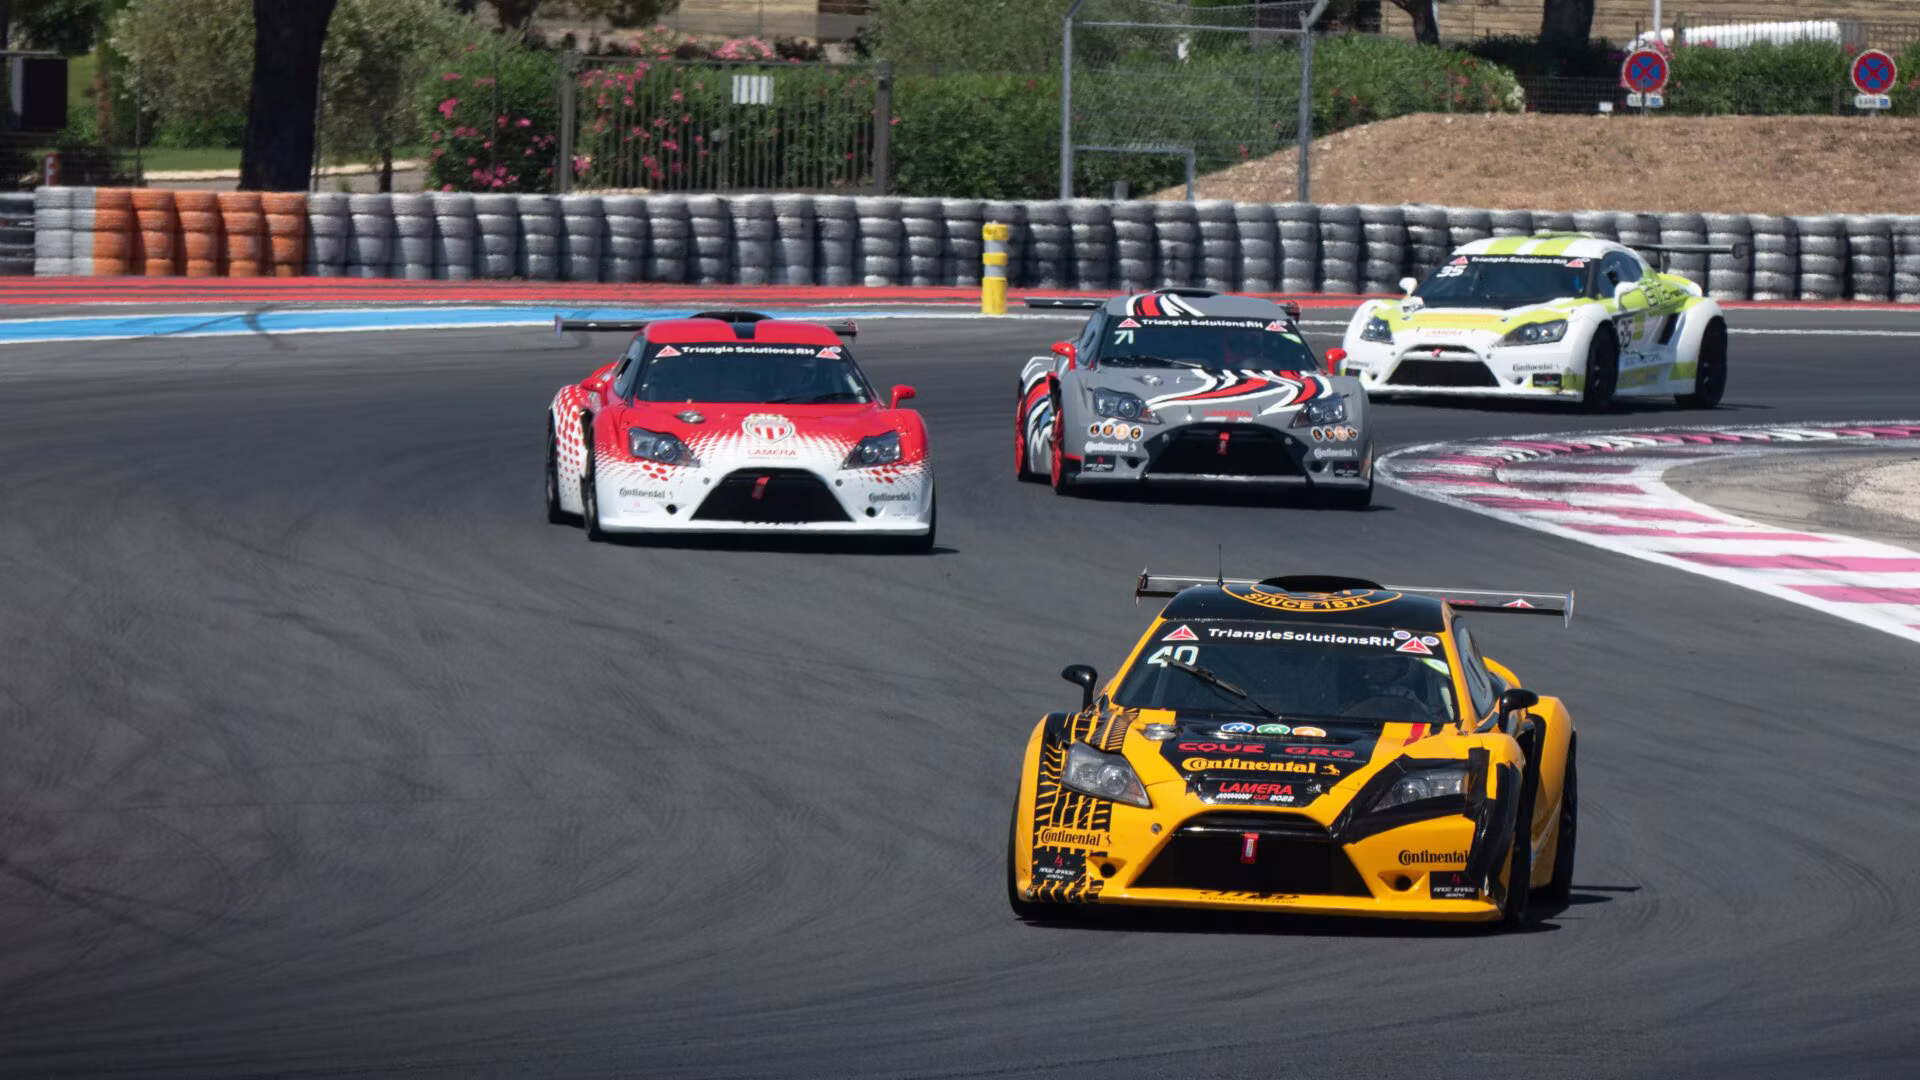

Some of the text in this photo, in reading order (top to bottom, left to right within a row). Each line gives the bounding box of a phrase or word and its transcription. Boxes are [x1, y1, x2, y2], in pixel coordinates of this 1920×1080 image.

[1436, 265, 1467, 278] 35
[1141, 319, 1189, 327] Triangle
[1190, 320, 1245, 328] Solutions
[1114, 330, 1135, 345] 71
[681, 346, 734, 355] Triangle
[736, 346, 794, 355] Solutions
[619, 487, 666, 499] Continental
[868, 492, 911, 503] Continental
[1244, 592, 1371, 610] SINCE 1871
[1147, 645, 1200, 668] 40
[1181, 757, 1317, 774] Continental
[1219, 782, 1292, 795] LAMERA
[1269, 795, 1295, 803] 2022
[1041, 828, 1100, 846] Continental
[1397, 849, 1469, 866] Continental
